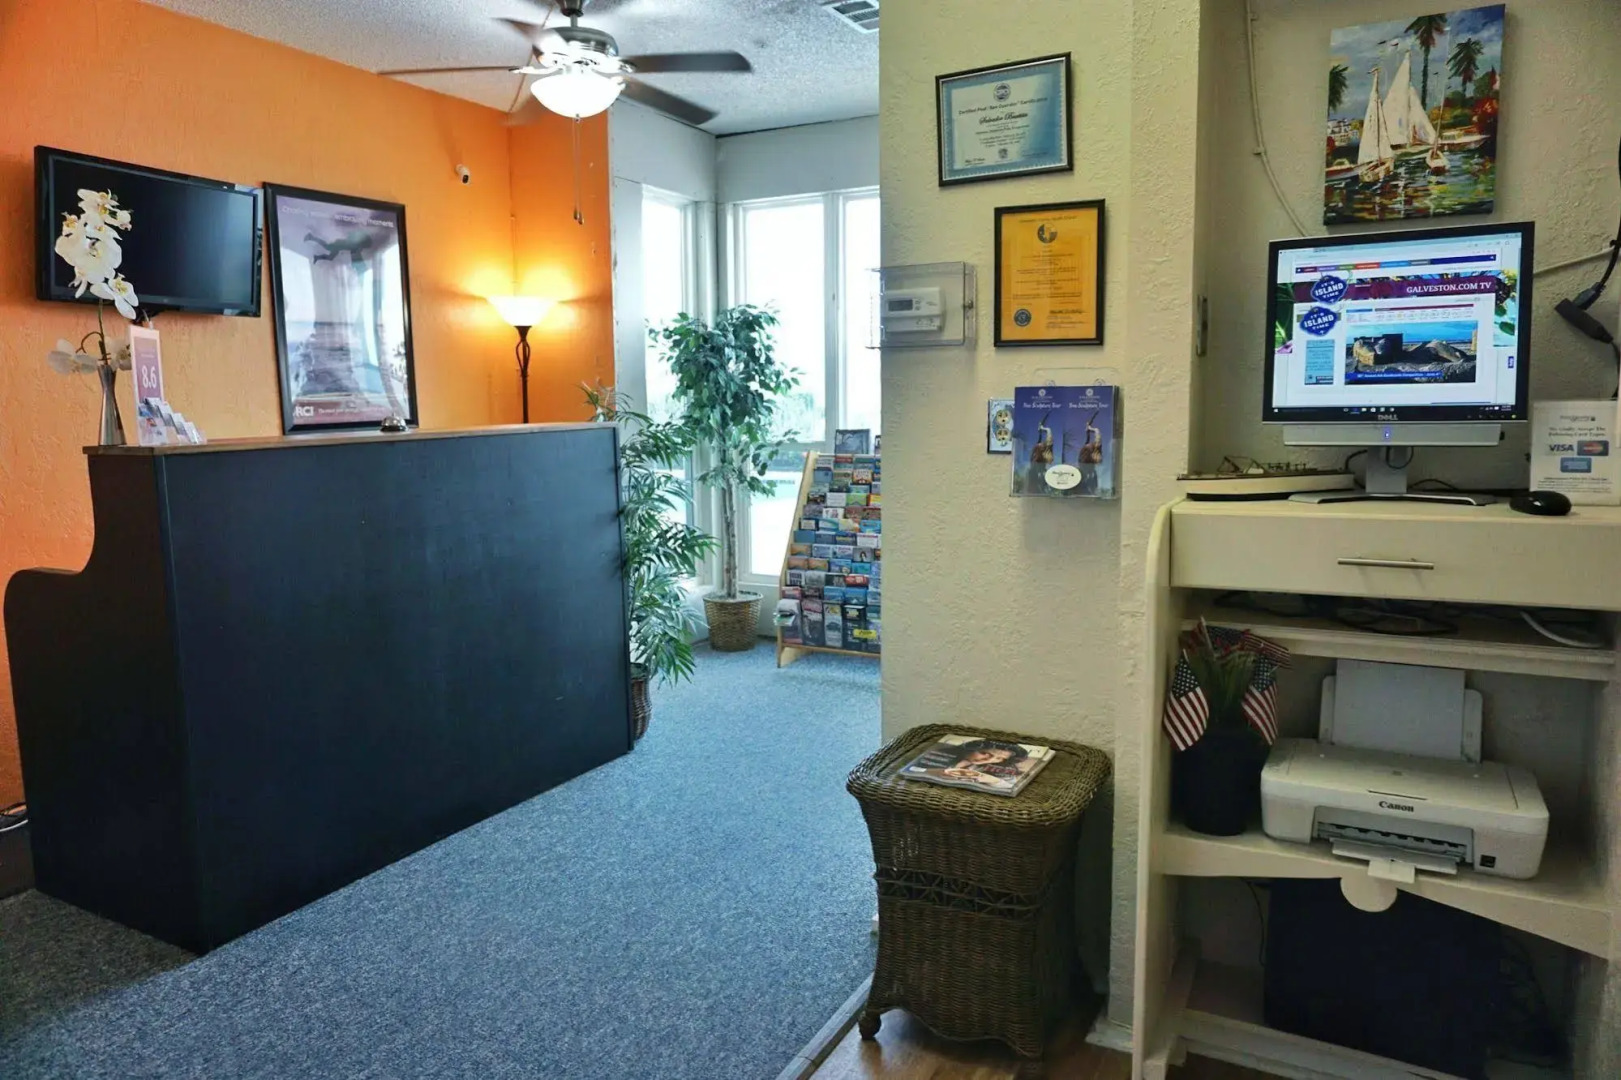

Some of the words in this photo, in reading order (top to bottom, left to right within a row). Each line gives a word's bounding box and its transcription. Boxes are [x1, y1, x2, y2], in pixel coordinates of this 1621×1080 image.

[1314, 282, 1344, 296] ISLAND
[1406, 282, 1478, 294] GALVESTON.COM
[1479, 281, 1492, 290] TV
[1322, 291, 1340, 299] TIME
[1303, 314, 1335, 328] ISLAND
[141, 365, 157, 389] 8.6
[295, 405, 314, 417] RCI
[1549, 444, 1575, 452] VISA
[1378, 800, 1415, 813] Canon
